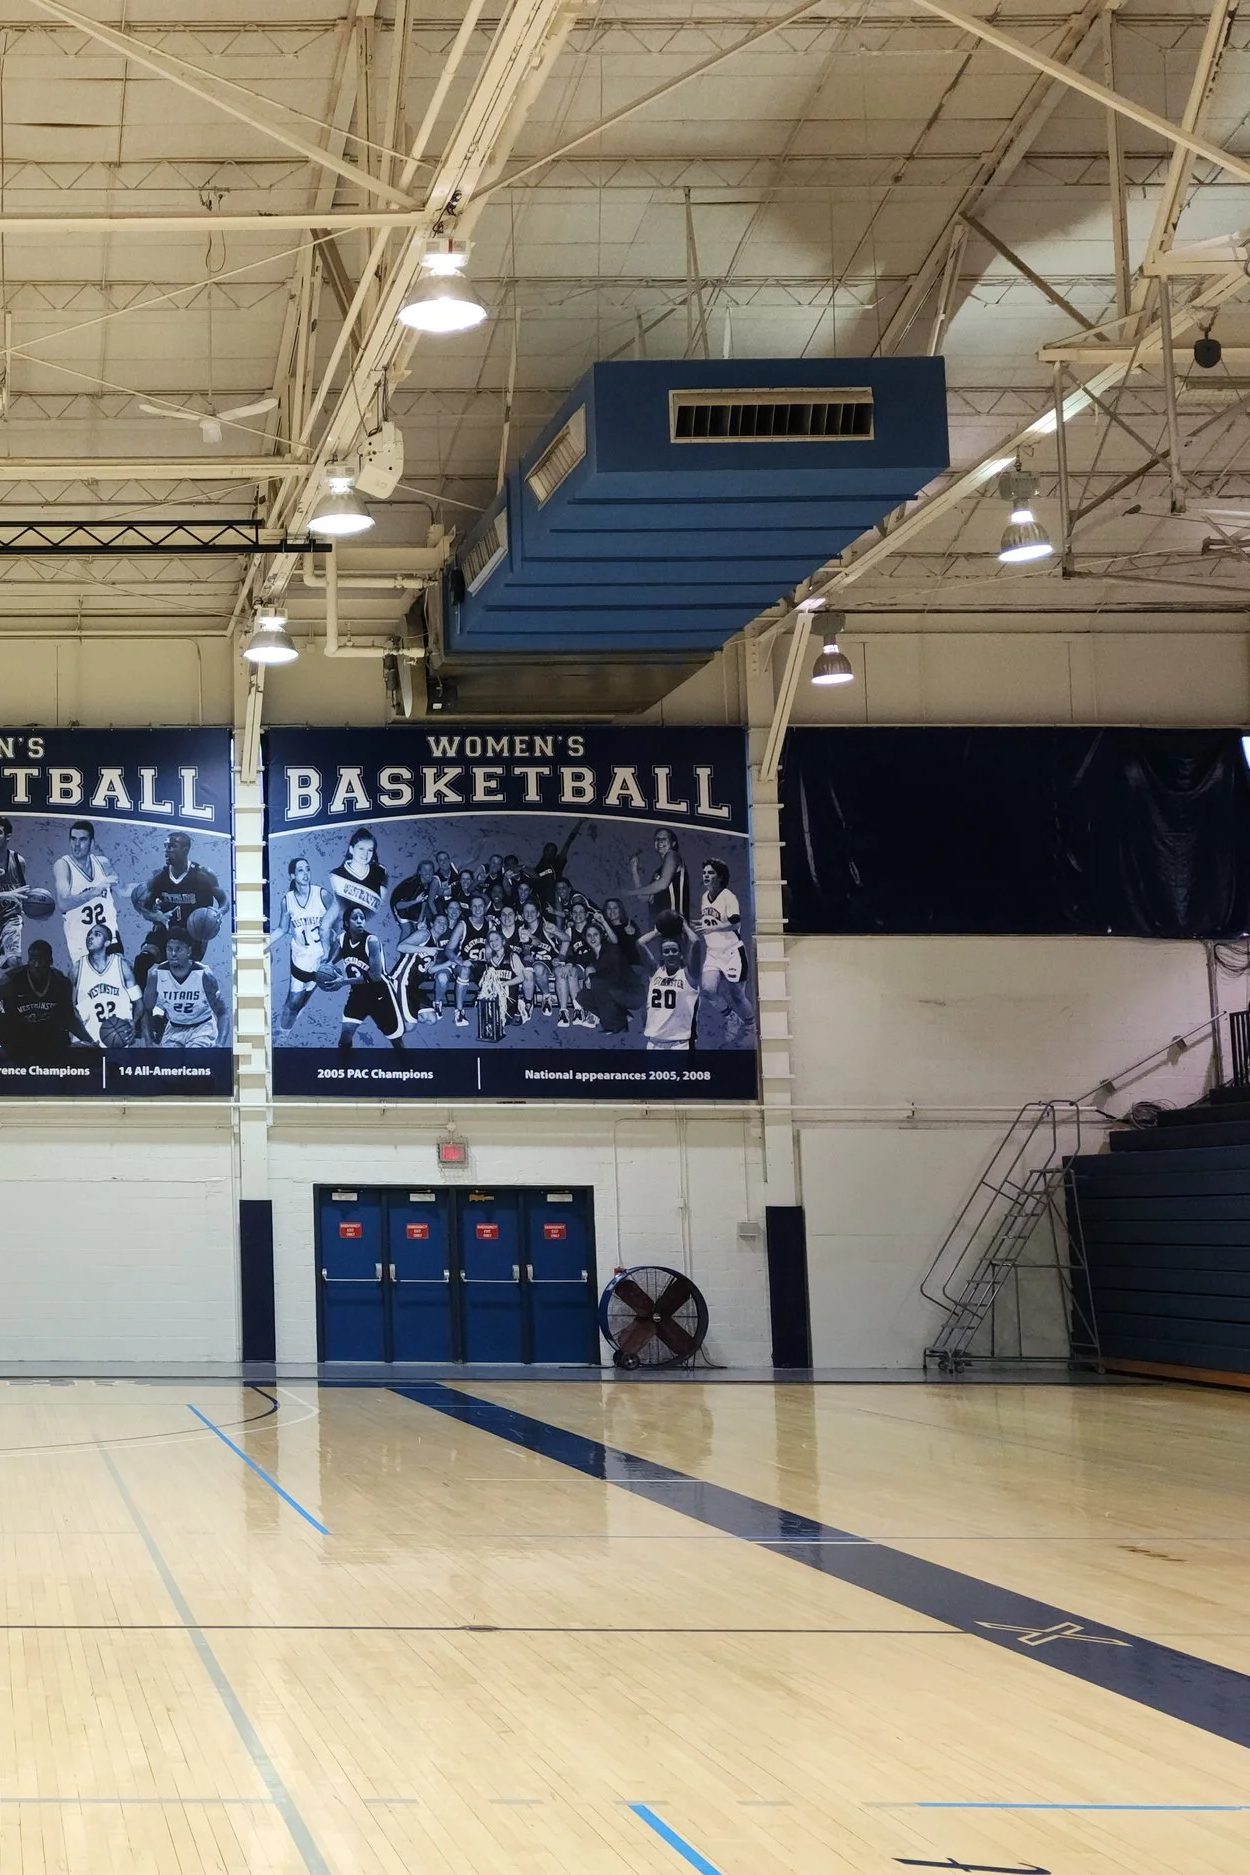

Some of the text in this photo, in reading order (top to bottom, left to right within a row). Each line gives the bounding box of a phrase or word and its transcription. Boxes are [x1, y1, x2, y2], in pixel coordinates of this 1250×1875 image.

[426, 735, 585, 758] WOMEN'S
[284, 764, 732, 821] BASKETBALL
[81, 903, 107, 925] 32
[163, 990, 200, 1001] TITANS
[651, 988, 677, 1010] 20
[173, 1003, 195, 1014] 22
[28, 1065, 91, 1078] Champions
[118, 1065, 211, 1076] 14 All-Americans
[317, 1068, 434, 1081] 2005 PAC Champions
[525, 1069, 711, 1083] National appearances 2005, 2008
